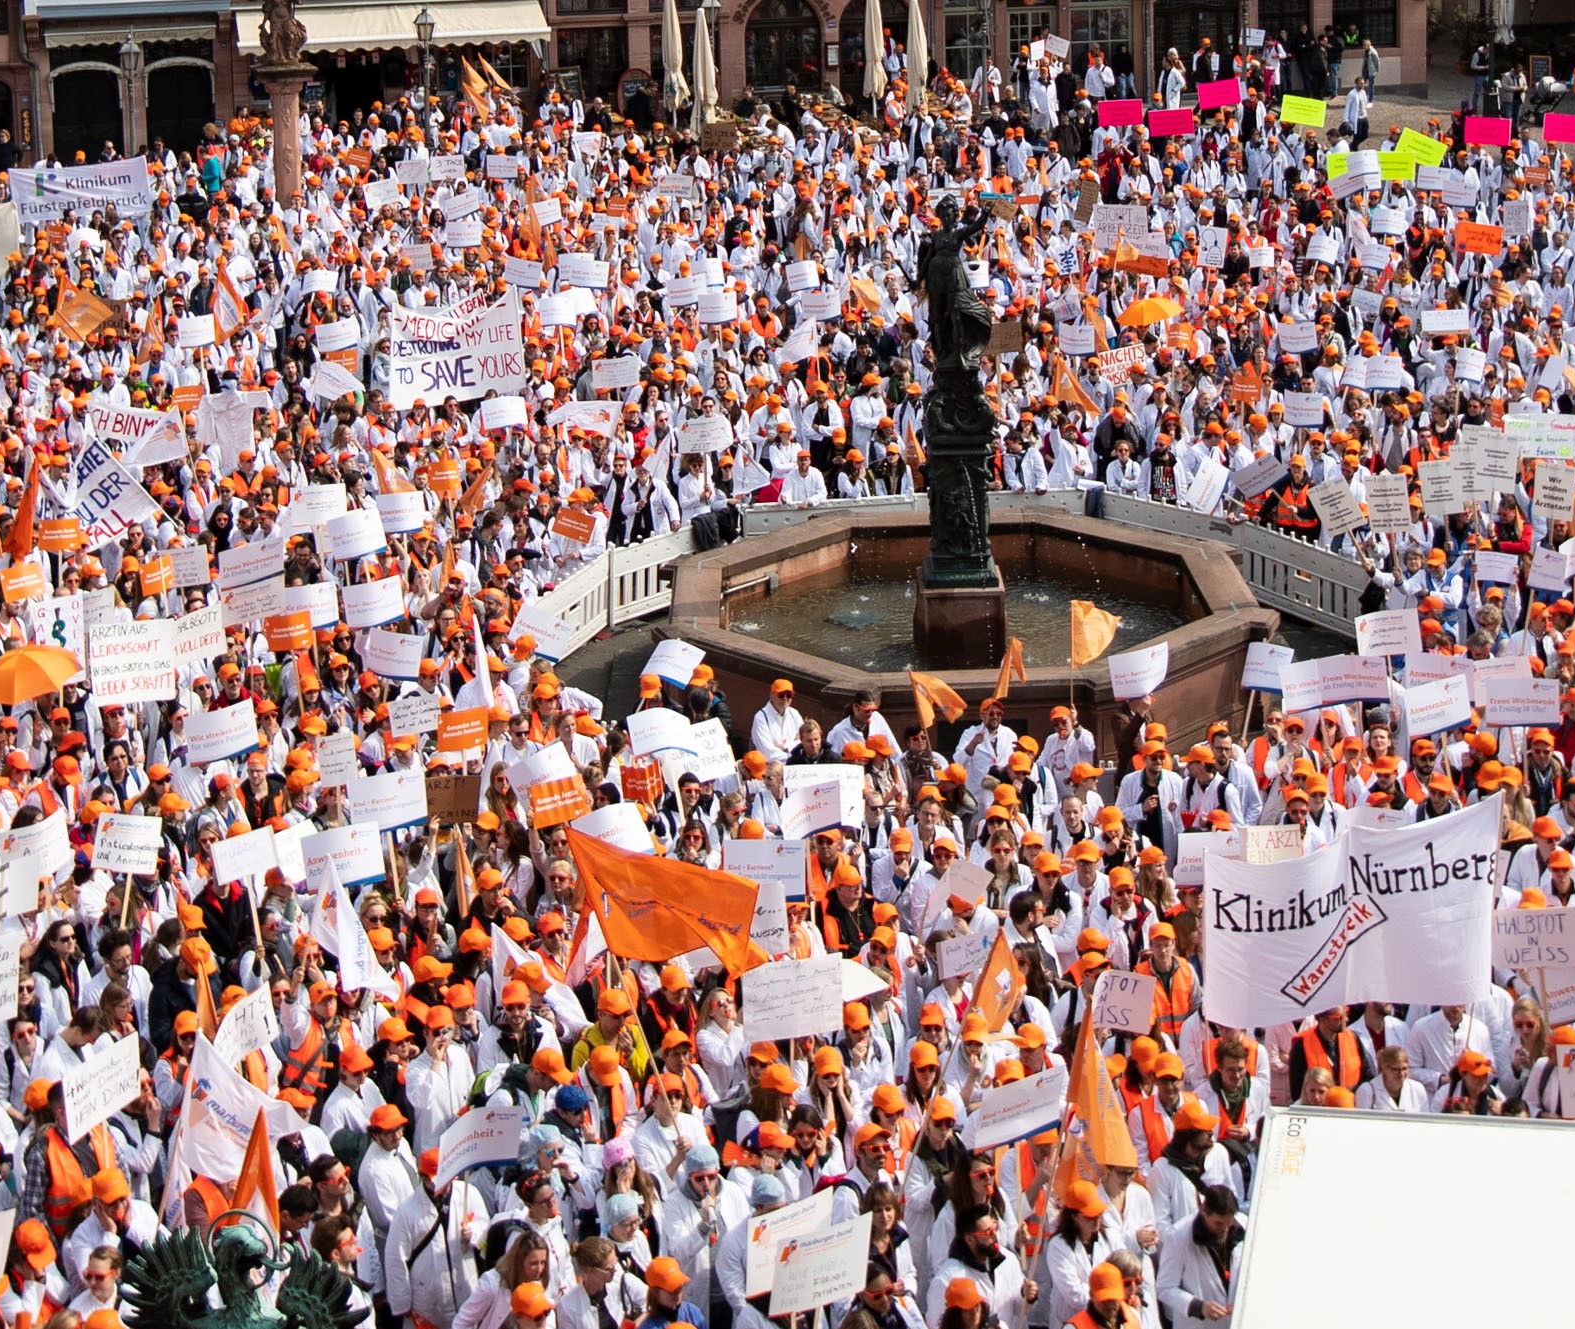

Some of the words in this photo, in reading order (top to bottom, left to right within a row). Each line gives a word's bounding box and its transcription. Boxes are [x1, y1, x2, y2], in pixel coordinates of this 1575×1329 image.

[65, 173, 132, 190] Klinikum
[20, 191, 147, 216] Fürstenfeldbruck
[465, 329, 484, 347] MY
[488, 323, 514, 343] LIFE
[1099, 345, 1145, 367] NACHTS
[395, 367, 414, 384] TO
[421, 355, 476, 392] SAVE
[477, 351, 522, 381] YOURS
[112, 412, 140, 437] BIN
[1541, 484, 1568, 494] wollen
[1548, 476, 1562, 484] Wir
[89, 471, 131, 510] DER
[1543, 493, 1565, 502] einen
[129, 623, 148, 634] AUS
[91, 638, 161, 659] LEIDENSCHAFT
[154, 660, 171, 670] DAS
[130, 672, 174, 692] SCHAFFT
[1322, 675, 1343, 683] Freies
[1343, 674, 1385, 683] Wochenende
[1489, 697, 1510, 706] Freies
[1511, 697, 1556, 706] Wochenende
[1264, 829, 1301, 849] ARZT
[1212, 883, 1347, 933] Klinikum
[1348, 842, 1497, 896] Nürnberg
[1495, 913, 1567, 936] HALBTOT
[1291, 901, 1374, 996] Warnstreik
[1527, 935, 1538, 946] IN
[1504, 946, 1570, 964] WEISS
